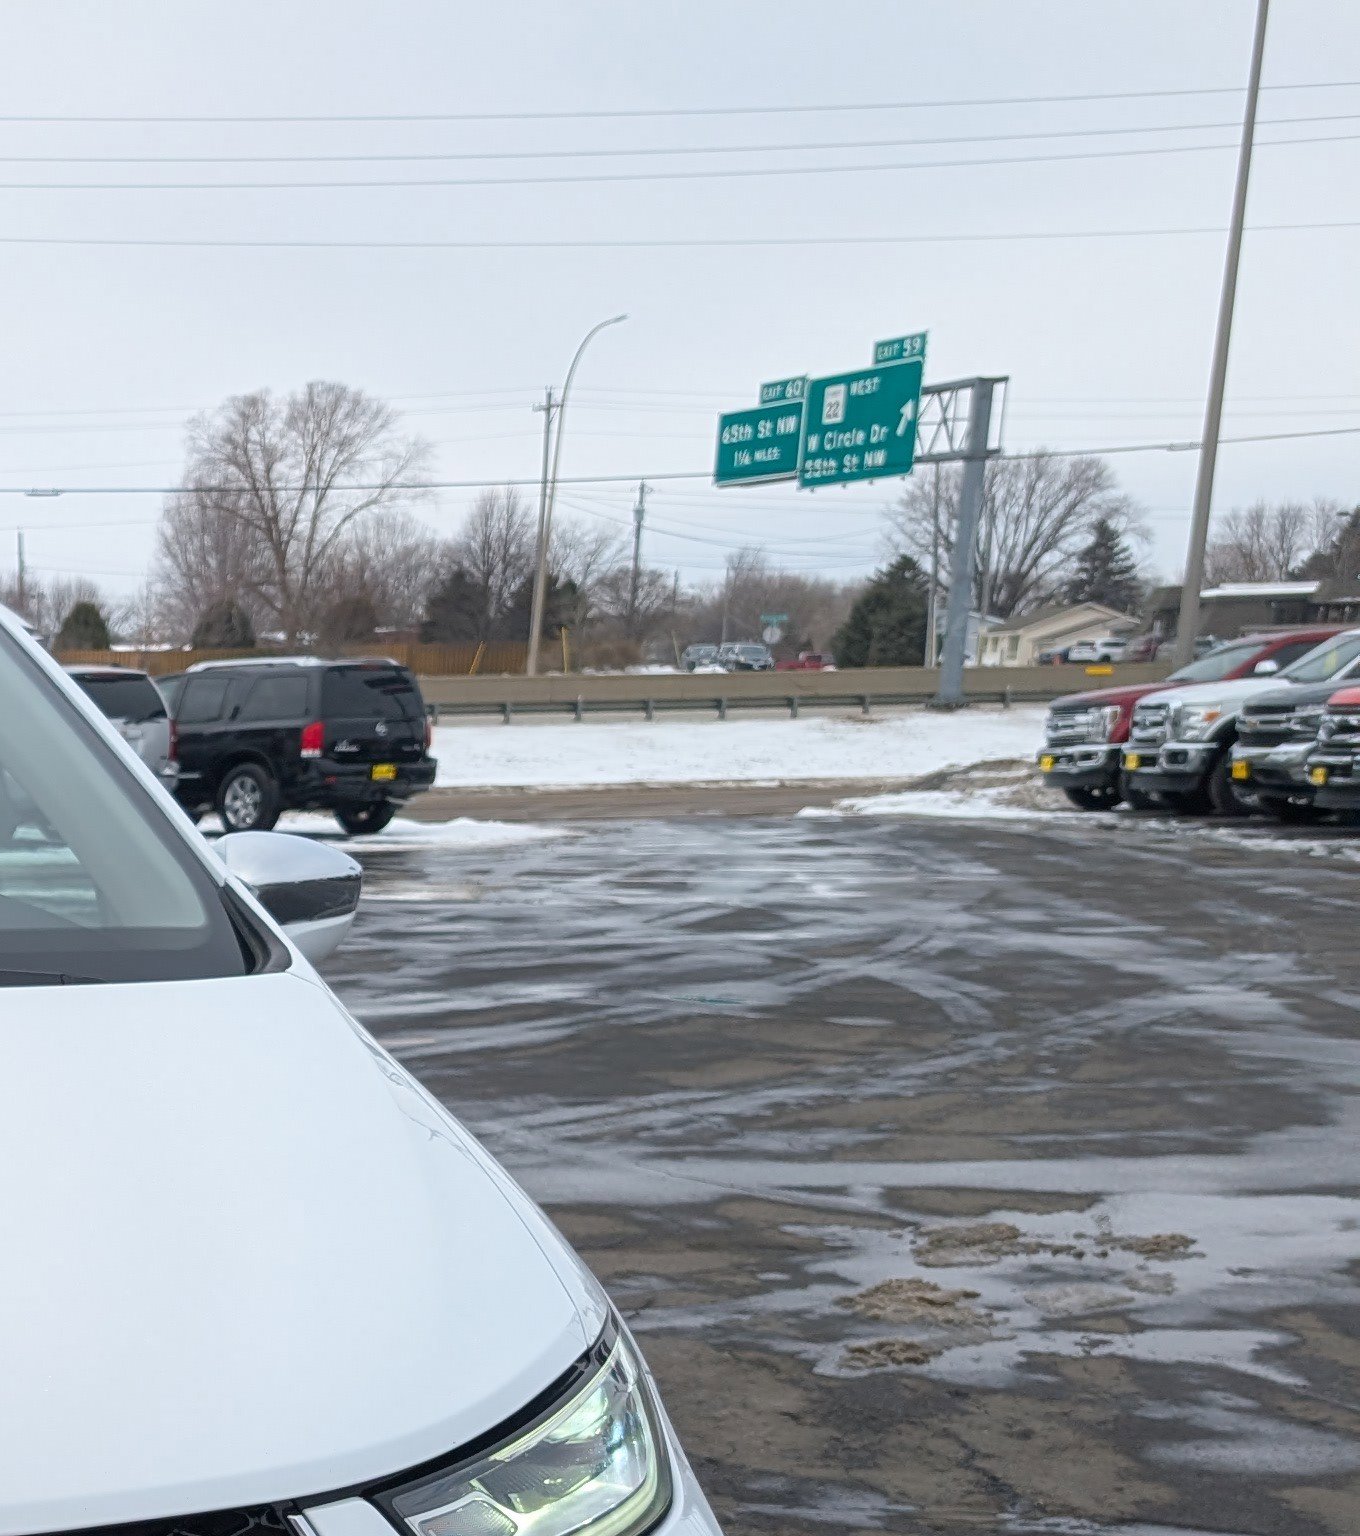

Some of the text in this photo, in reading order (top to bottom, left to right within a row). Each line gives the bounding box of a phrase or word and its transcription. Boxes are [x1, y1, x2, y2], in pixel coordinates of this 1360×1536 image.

[902, 337, 921, 357] 59
[785, 380, 802, 398] 60
[849, 377, 881, 396] WEST
[825, 401, 840, 419] 22
[722, 415, 797, 444] 65th St NW
[807, 423, 890, 453] W Circle Dr
[842, 453, 860, 474] St
[864, 449, 887, 470] NW
